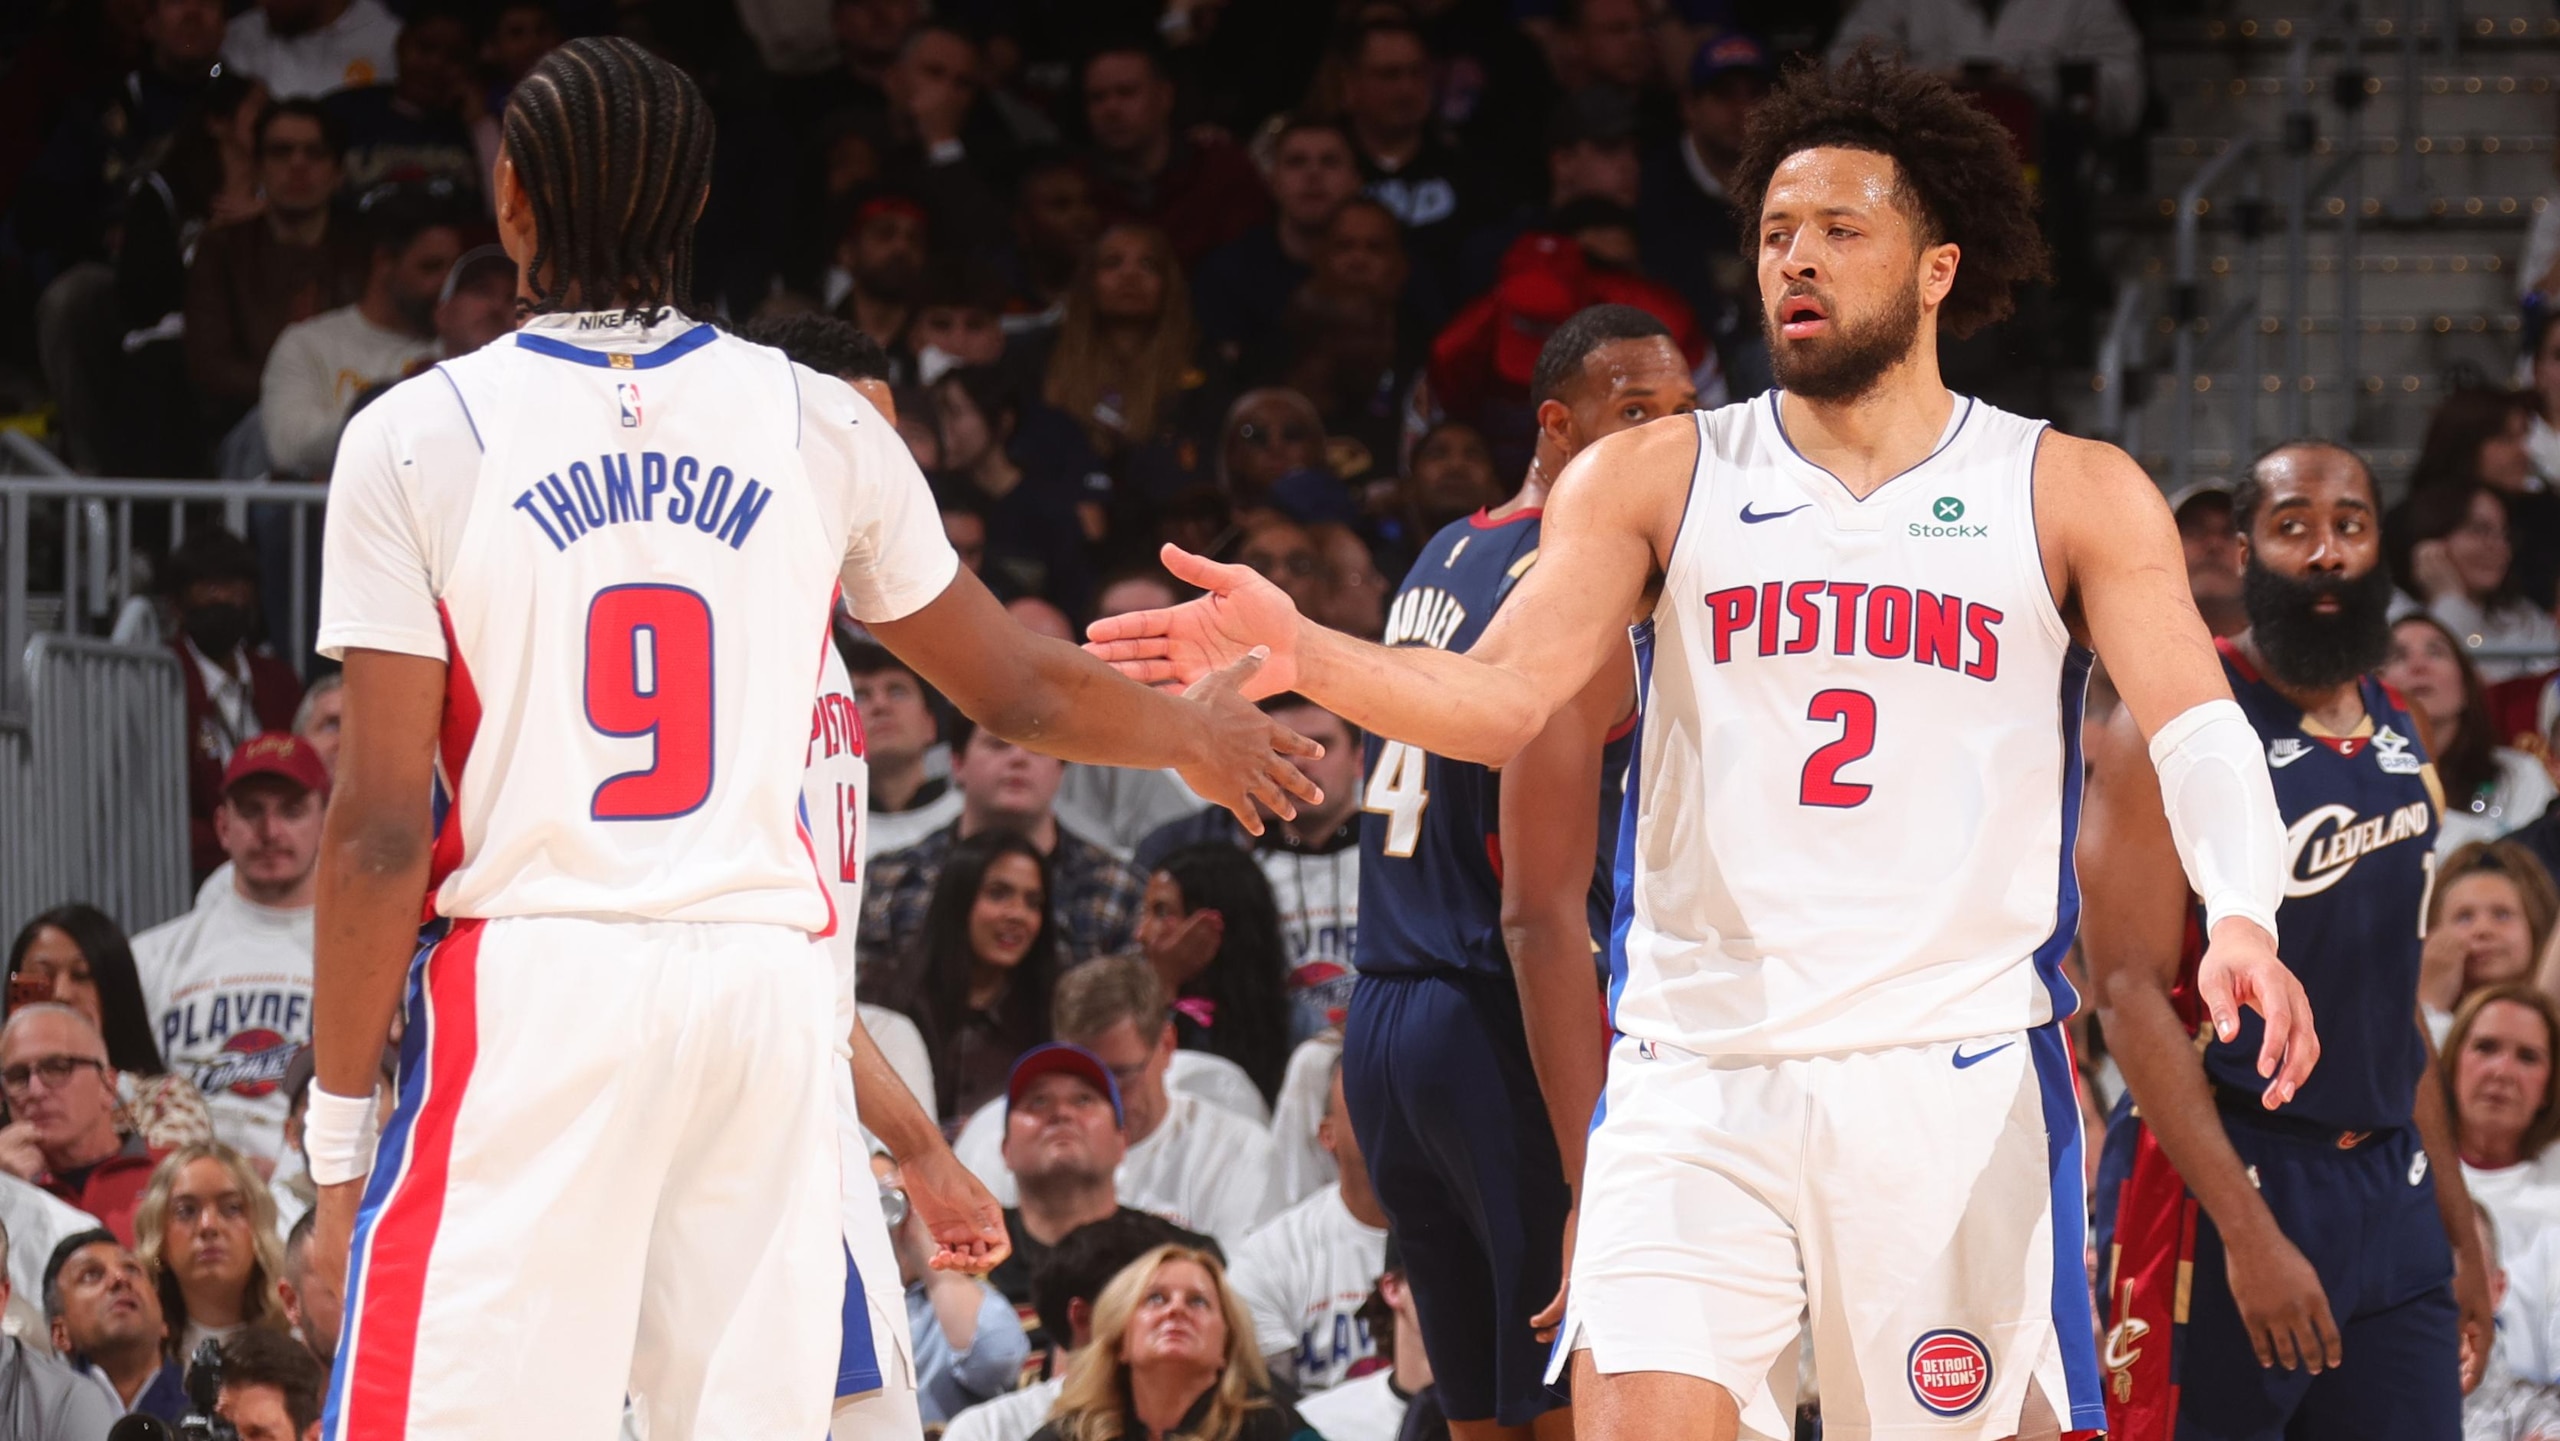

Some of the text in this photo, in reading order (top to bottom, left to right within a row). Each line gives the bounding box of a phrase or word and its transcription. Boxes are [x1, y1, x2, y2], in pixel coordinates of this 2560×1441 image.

[578, 313, 619, 331] NIKE
[512, 451, 774, 553] THOMPSON
[1908, 523, 1988, 538] StockX
[1704, 580, 2004, 682] PISTONS
[583, 582, 715, 822] 9
[806, 693, 870, 769] PISTO
[1799, 688, 1877, 809] 2
[2272, 738, 2301, 756] NIKE
[2339, 740, 2354, 755] C
[836, 782, 857, 884] 12
[1362, 738, 1429, 858] 4
[2284, 802, 2429, 898] CLEVELAND
[2416, 851, 2436, 939] 1
[163, 989, 313, 1060] PLAYOF
[1921, 1356, 1974, 1373] DETROIT
[1922, 1370, 1977, 1388] PISTONS
